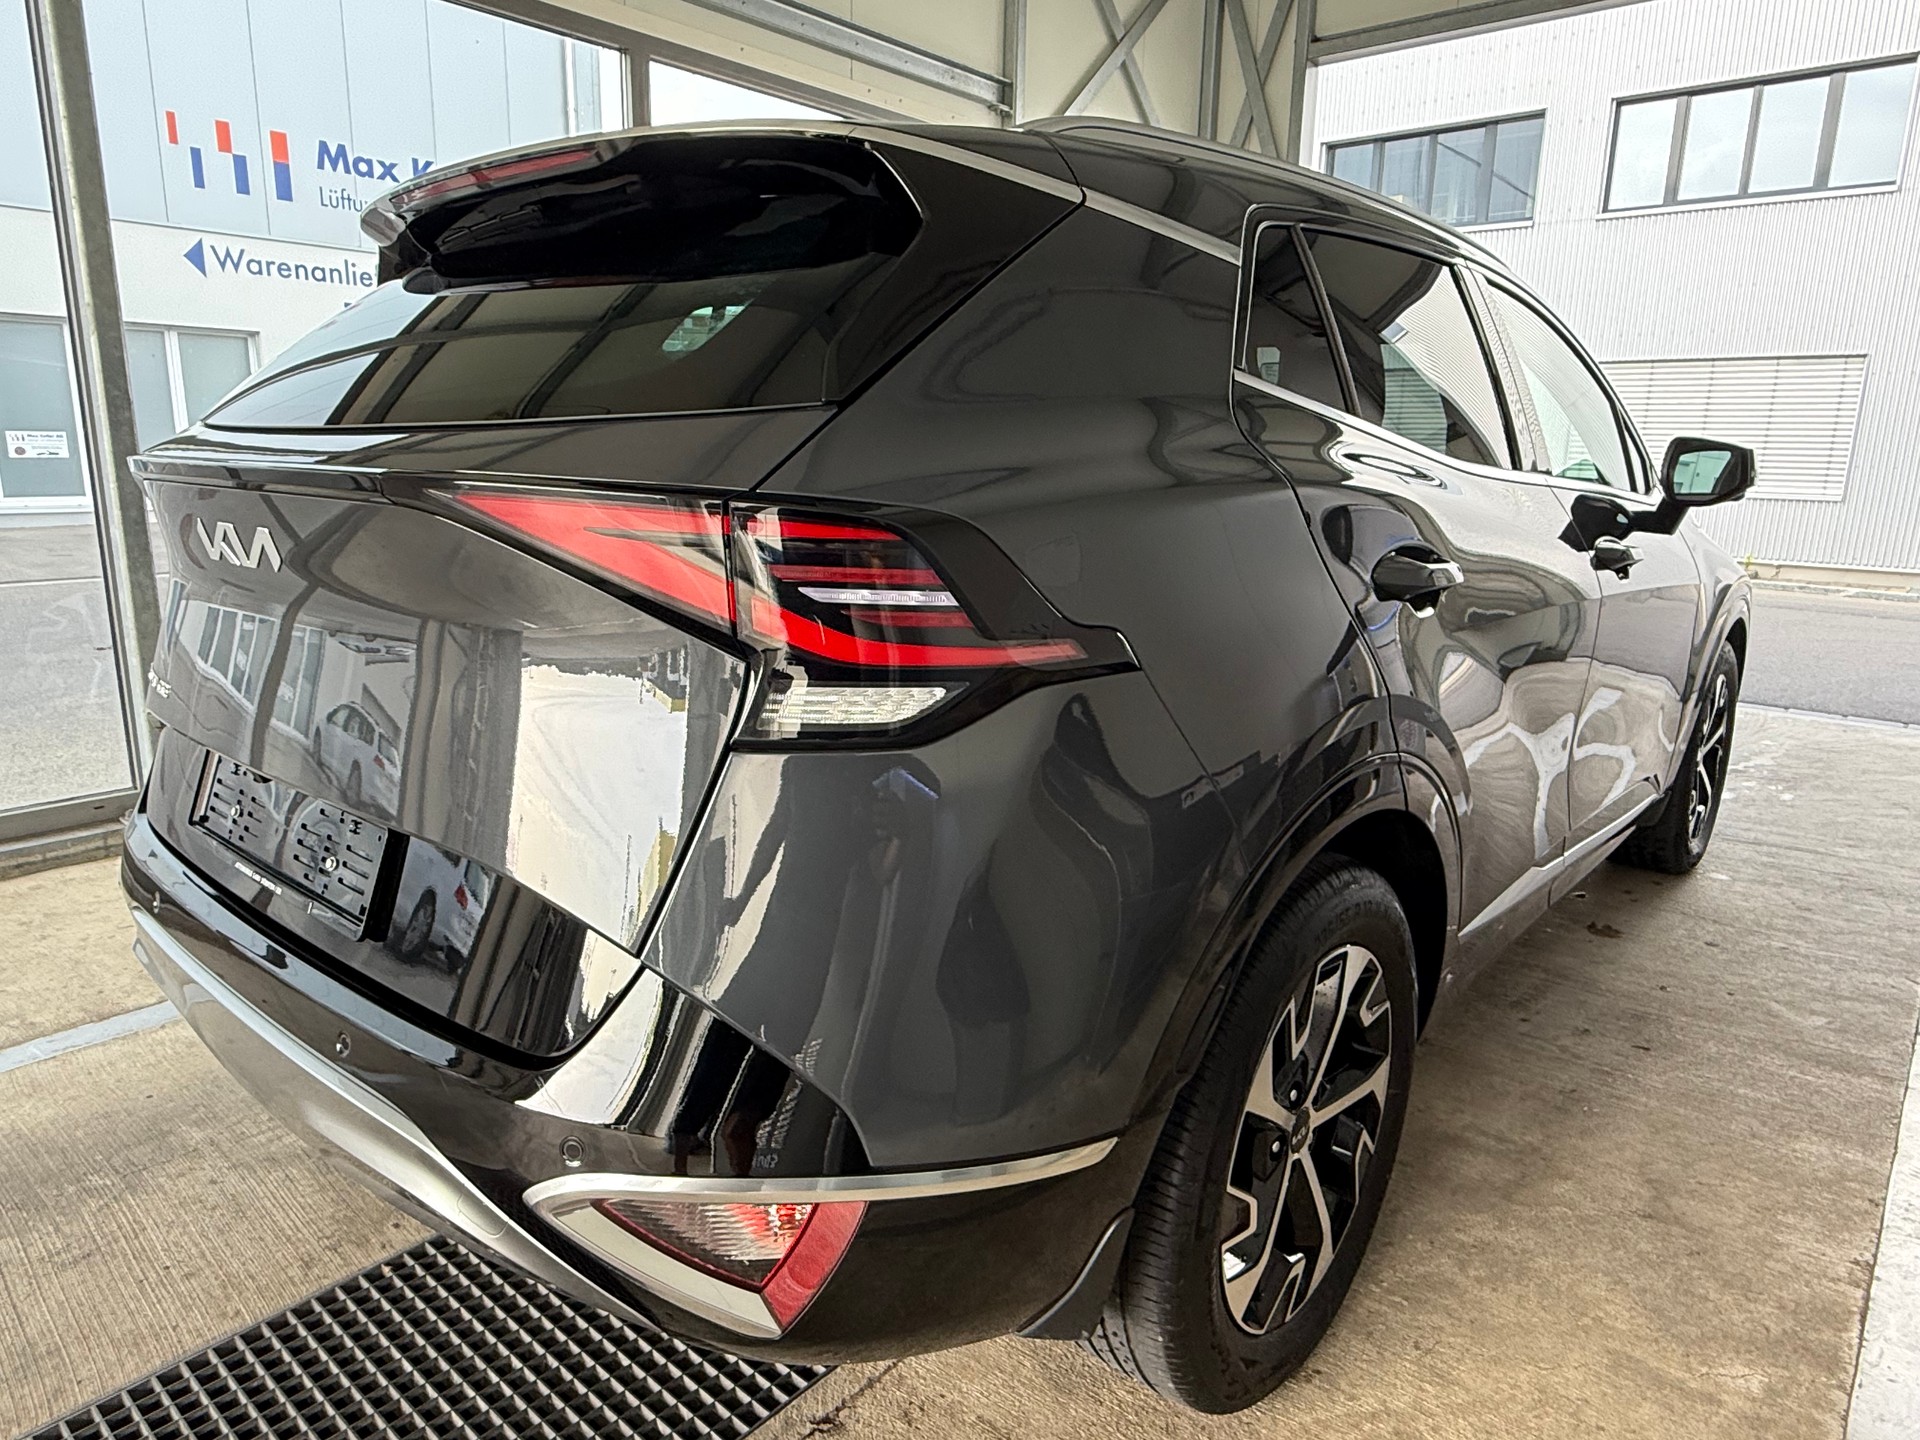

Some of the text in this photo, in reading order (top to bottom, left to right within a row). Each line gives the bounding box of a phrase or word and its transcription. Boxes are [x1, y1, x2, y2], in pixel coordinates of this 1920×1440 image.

[317, 139, 400, 183] Max
[318, 186, 368, 213] Lüftu
[210, 245, 379, 288] Warenanlie
[197, 517, 283, 573] KIA
